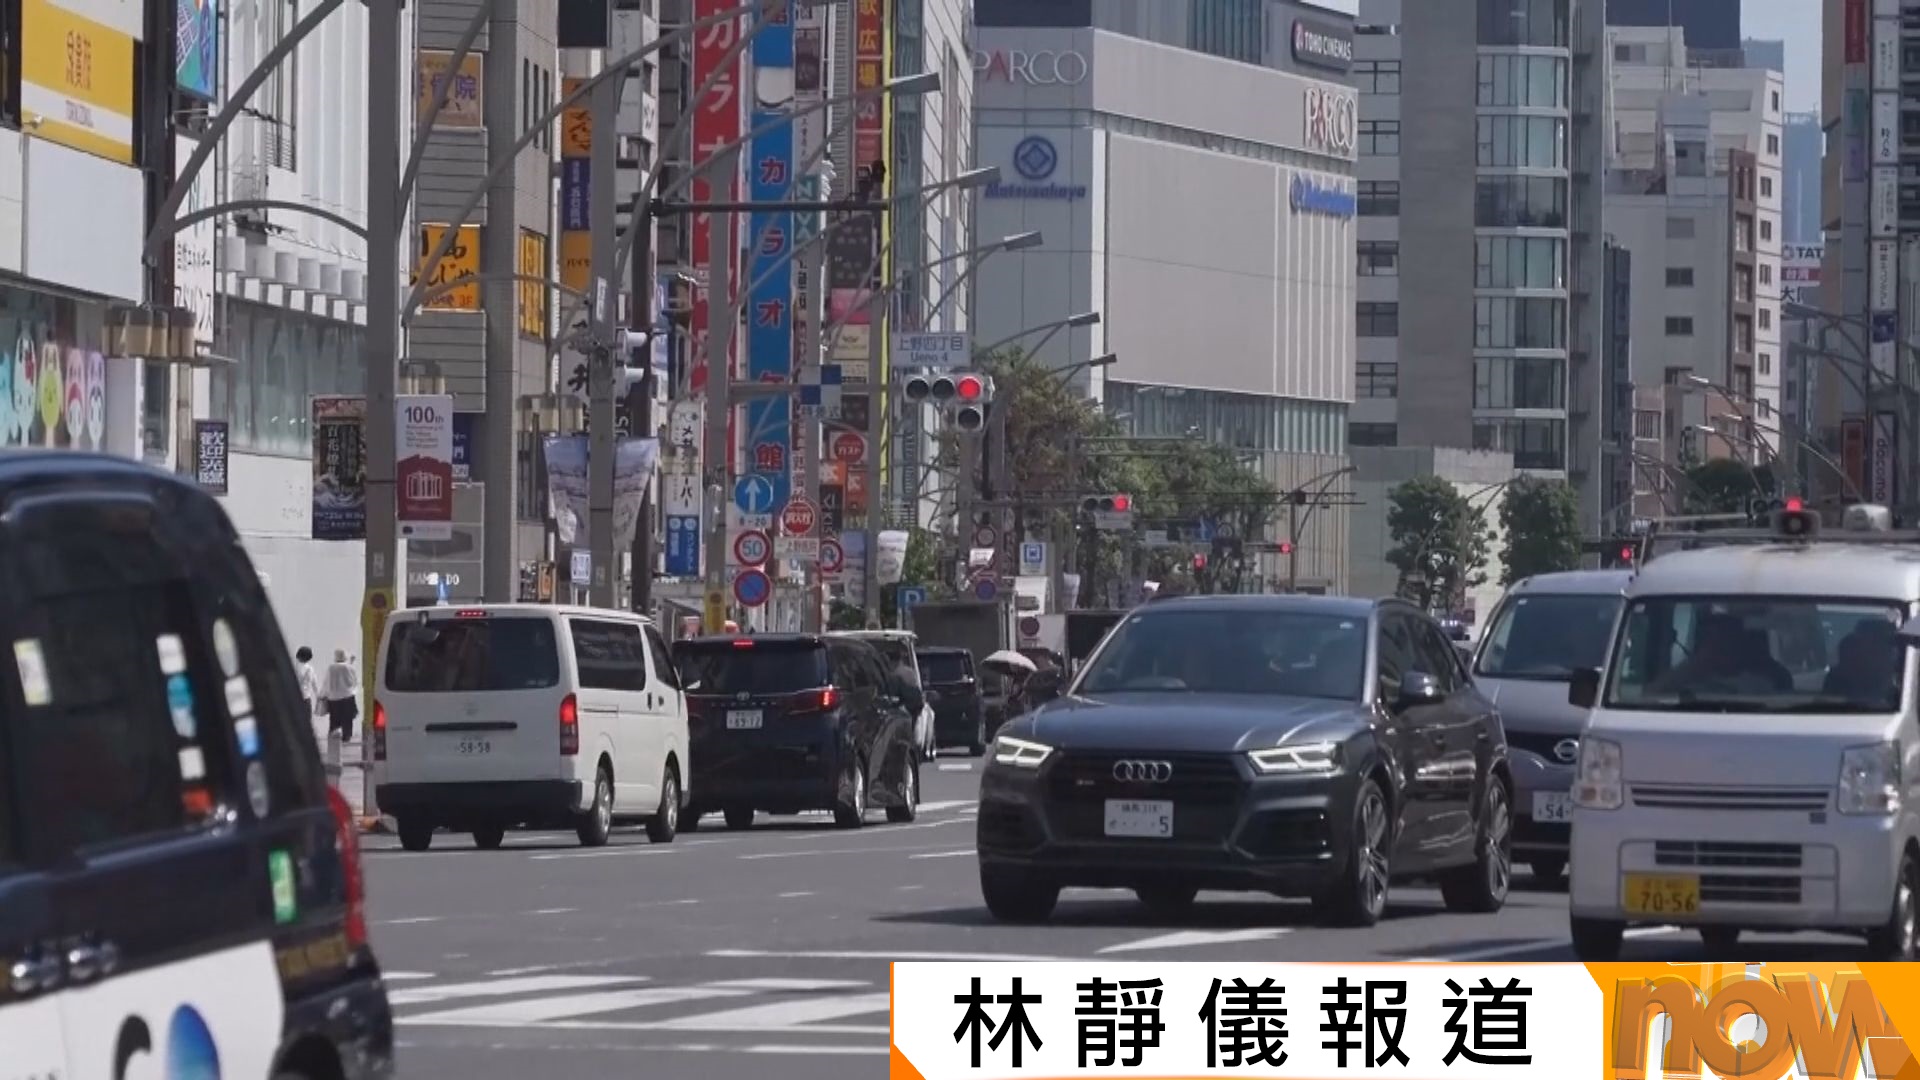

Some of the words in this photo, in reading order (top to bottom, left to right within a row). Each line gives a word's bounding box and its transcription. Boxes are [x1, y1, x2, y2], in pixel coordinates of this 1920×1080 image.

[972, 50, 1088, 85] PARCO
[1303, 88, 1356, 150] PARCO
[896, 335, 964, 351] 上野四丁目
[910, 351, 938, 362] Ueno
[942, 351, 949, 362] 4
[404, 406, 445, 423] 100th
[741, 540, 765, 557] 50
[1159, 816, 1169, 834] 5
[1640, 891, 1695, 912] 70-56
